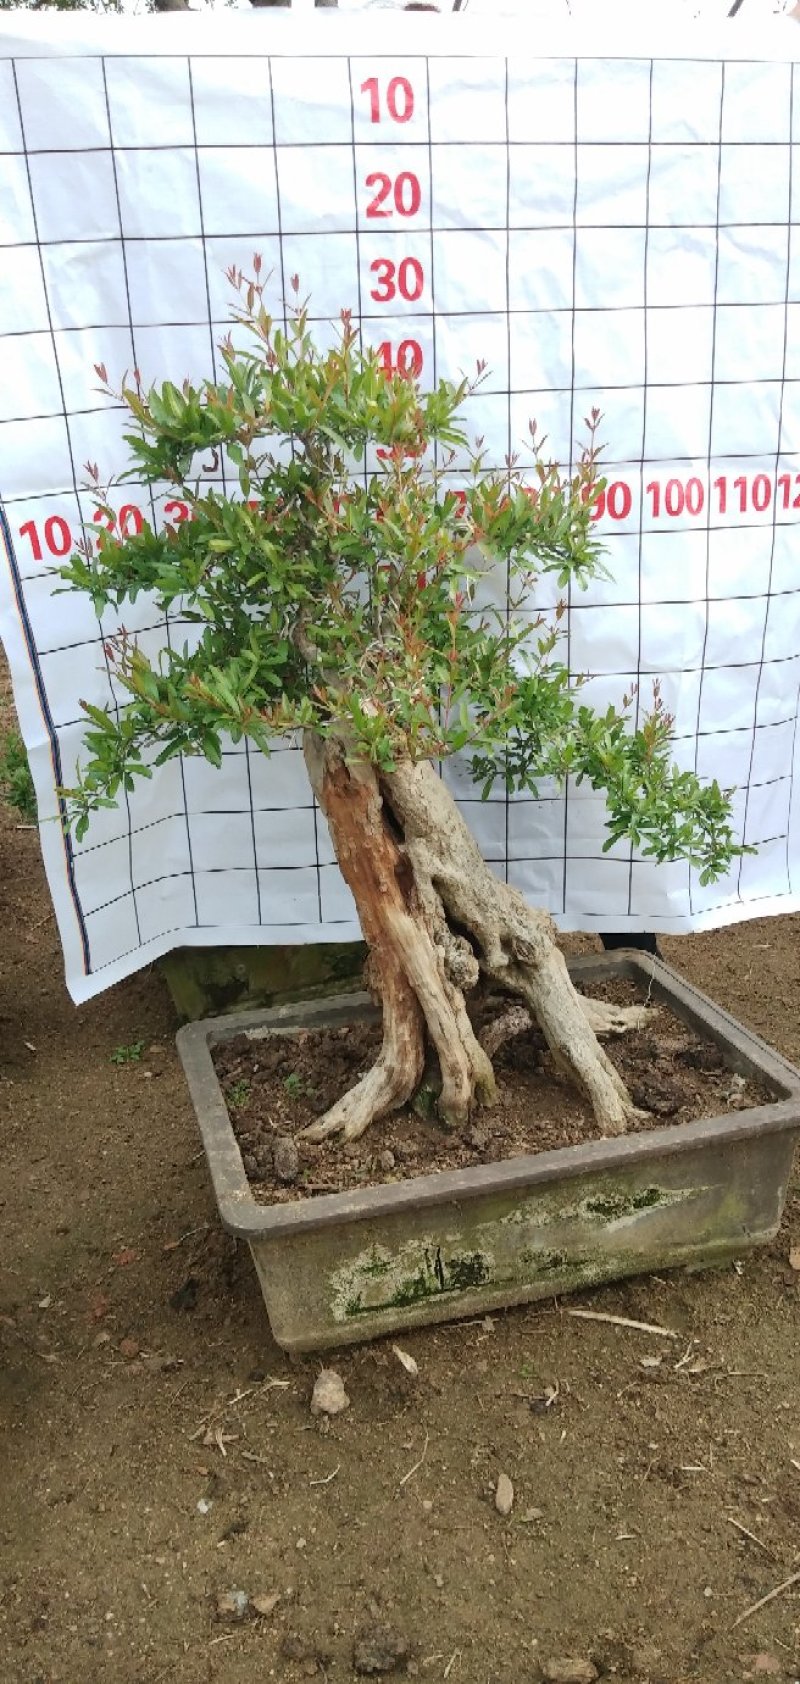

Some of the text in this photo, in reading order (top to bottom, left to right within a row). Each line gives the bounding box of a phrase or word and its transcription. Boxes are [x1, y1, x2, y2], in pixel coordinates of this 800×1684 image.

[361, 76, 414, 123] 10
[365, 171, 421, 219] 20
[370, 257, 424, 302] 30
[19, 515, 72, 560] 10
[646, 477, 704, 518] 100
[714, 474, 771, 513] 110
